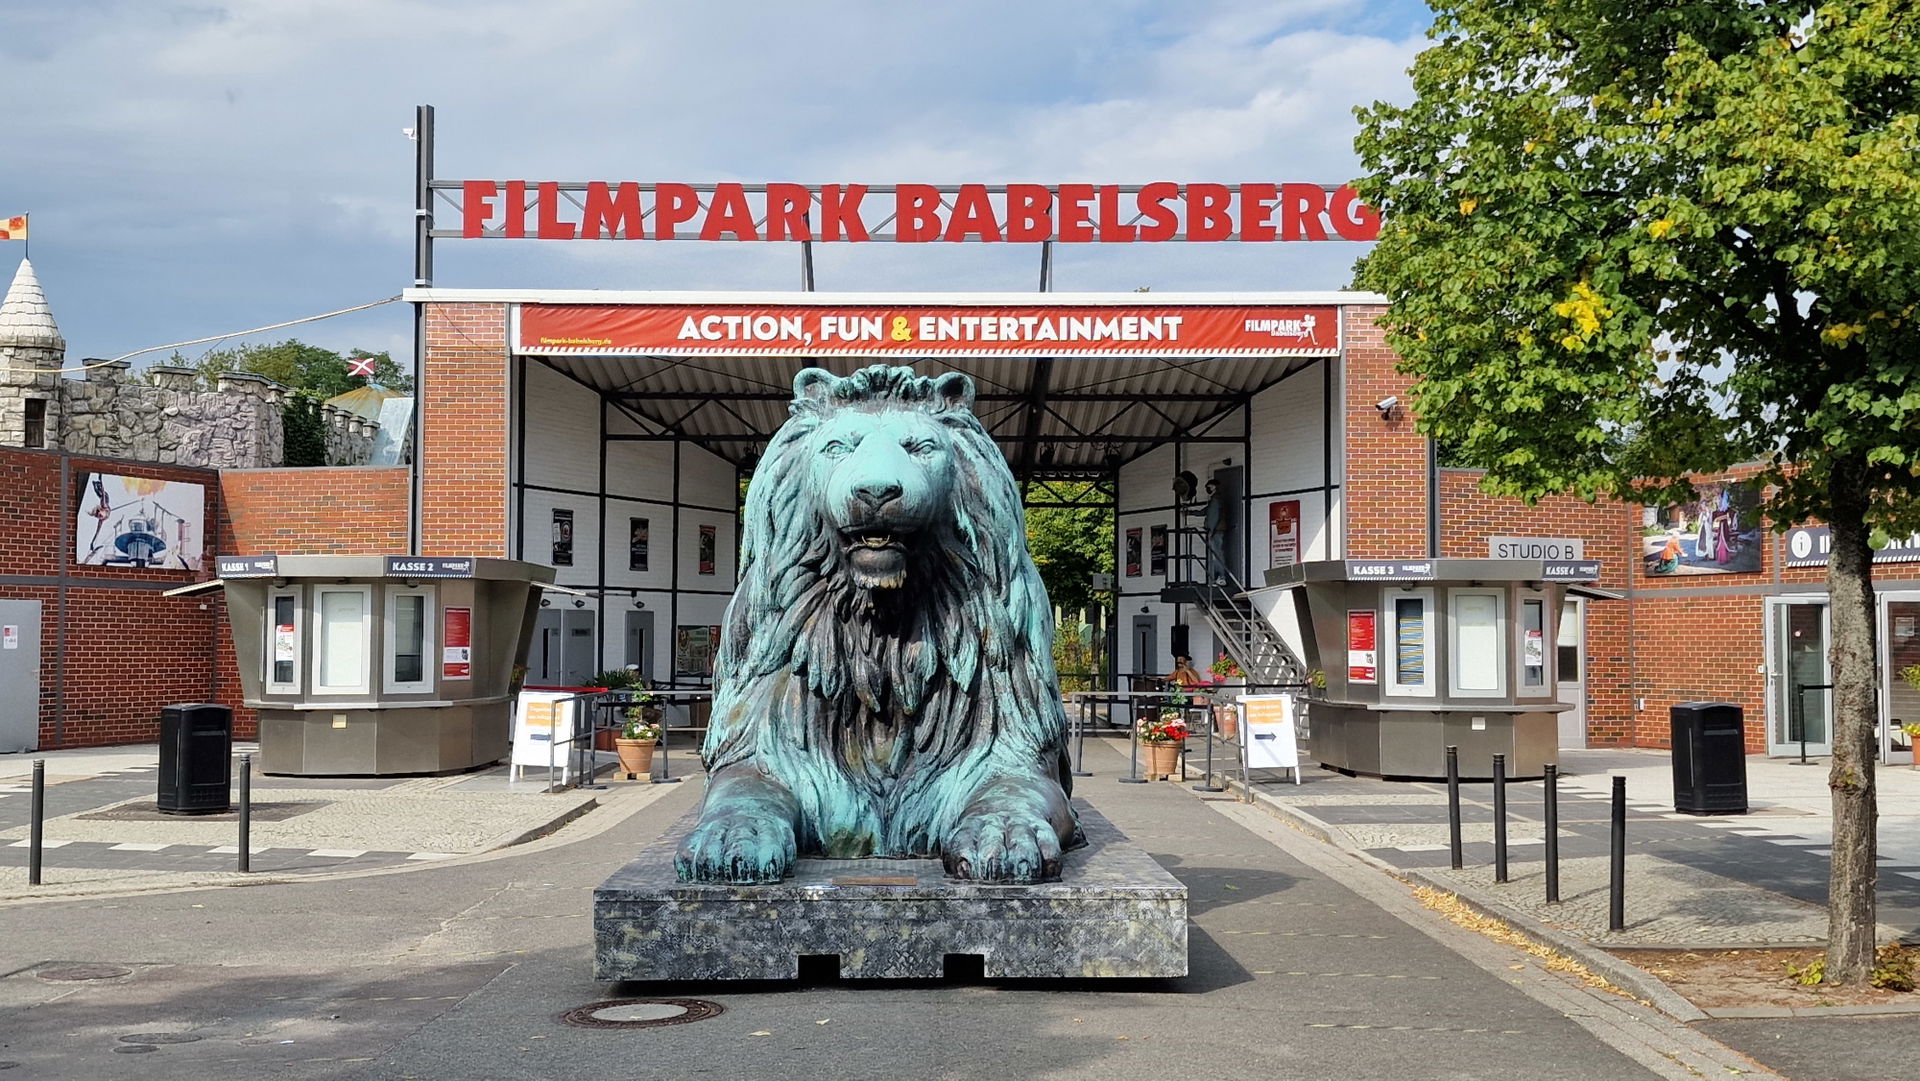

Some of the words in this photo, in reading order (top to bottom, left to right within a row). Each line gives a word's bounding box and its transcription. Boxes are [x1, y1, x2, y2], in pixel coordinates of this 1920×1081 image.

[463, 180, 869, 242] FILMPARK
[895, 182, 1381, 242] BABELSBERG
[677, 315, 812, 346] ACTION,
[820, 316, 883, 341] FUN
[891, 316, 912, 341] &
[919, 316, 1182, 341] ENTERTAINMENT
[1245, 319, 1301, 331] FILMPARK
[1497, 543, 1560, 560] STUDIO
[1564, 545, 1575, 560] B
[244, 562, 249, 572] 1
[392, 561, 426, 571] KASSE
[427, 562, 434, 572] 2
[1353, 565, 1386, 575] KASSE
[1387, 565, 1395, 575] 3
[1545, 566, 1569, 575] KASSE
[1569, 566, 1575, 575] 4
